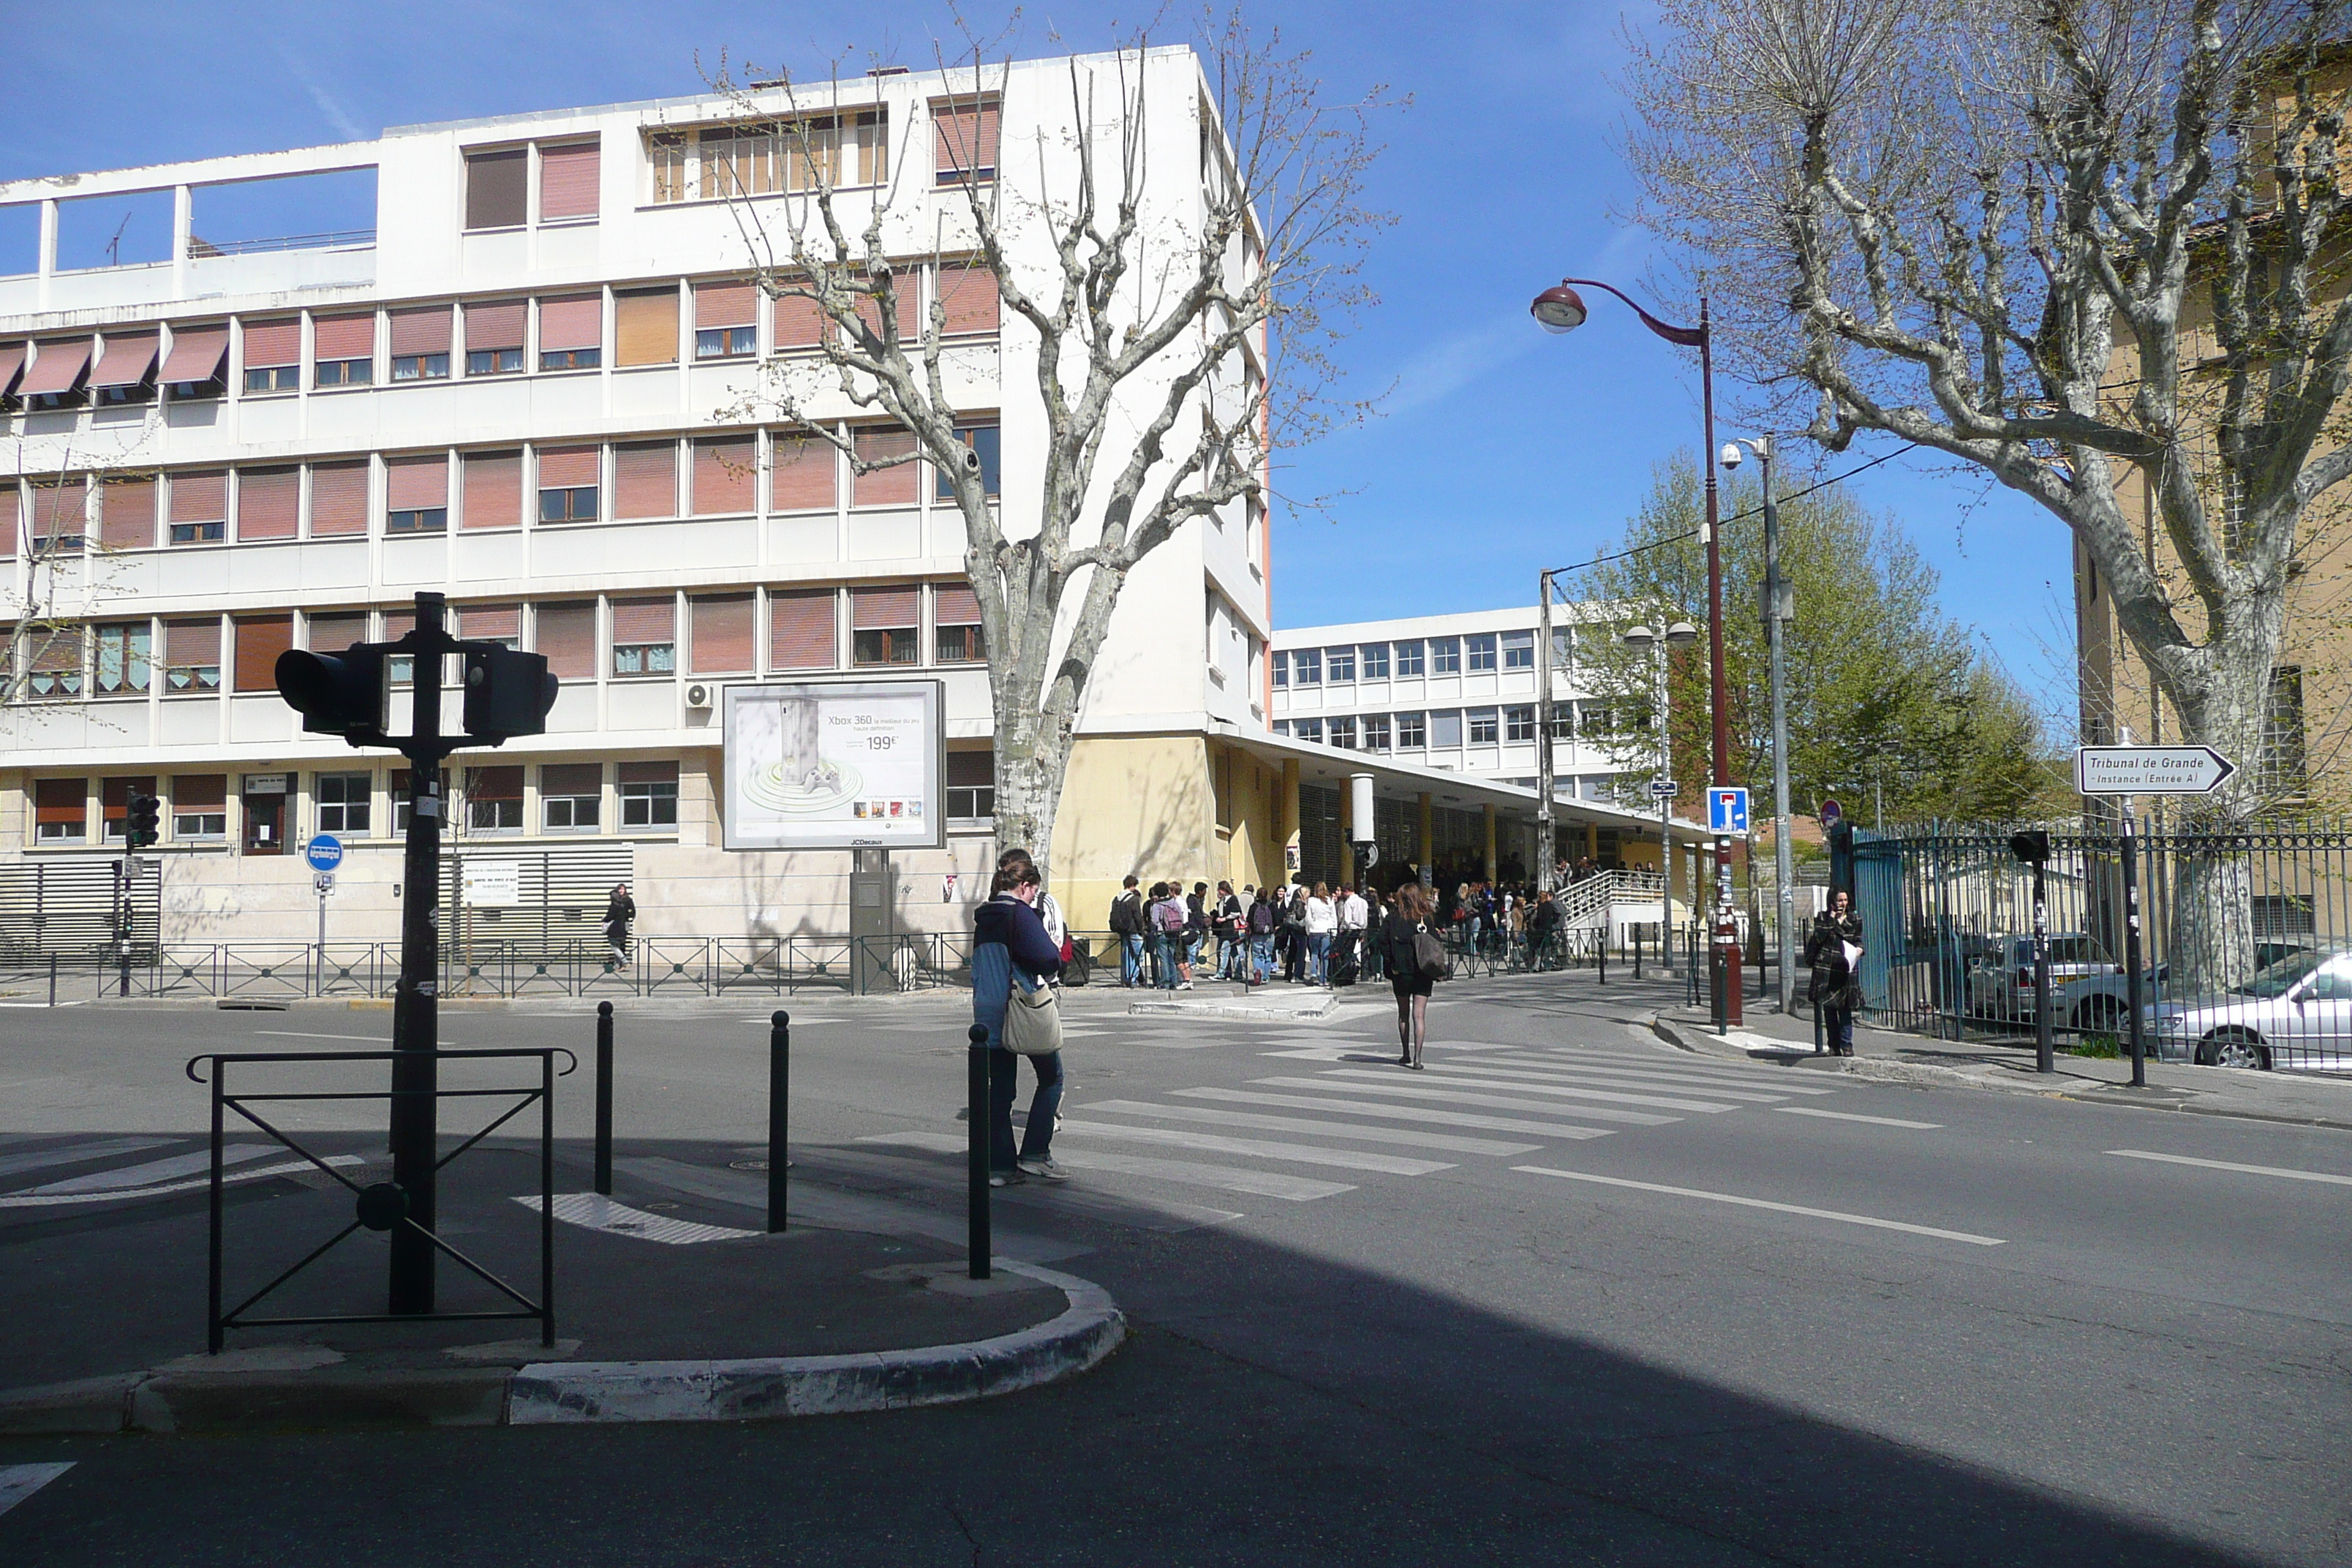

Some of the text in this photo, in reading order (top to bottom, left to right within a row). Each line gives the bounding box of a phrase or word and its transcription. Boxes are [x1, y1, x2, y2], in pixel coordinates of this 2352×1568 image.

[829, 716, 851, 725] Xbox
[2091, 758, 2204, 768] Tribunal de Grande
[2145, 772, 2182, 783] (Entrée
[2186, 772, 2198, 783] A)
